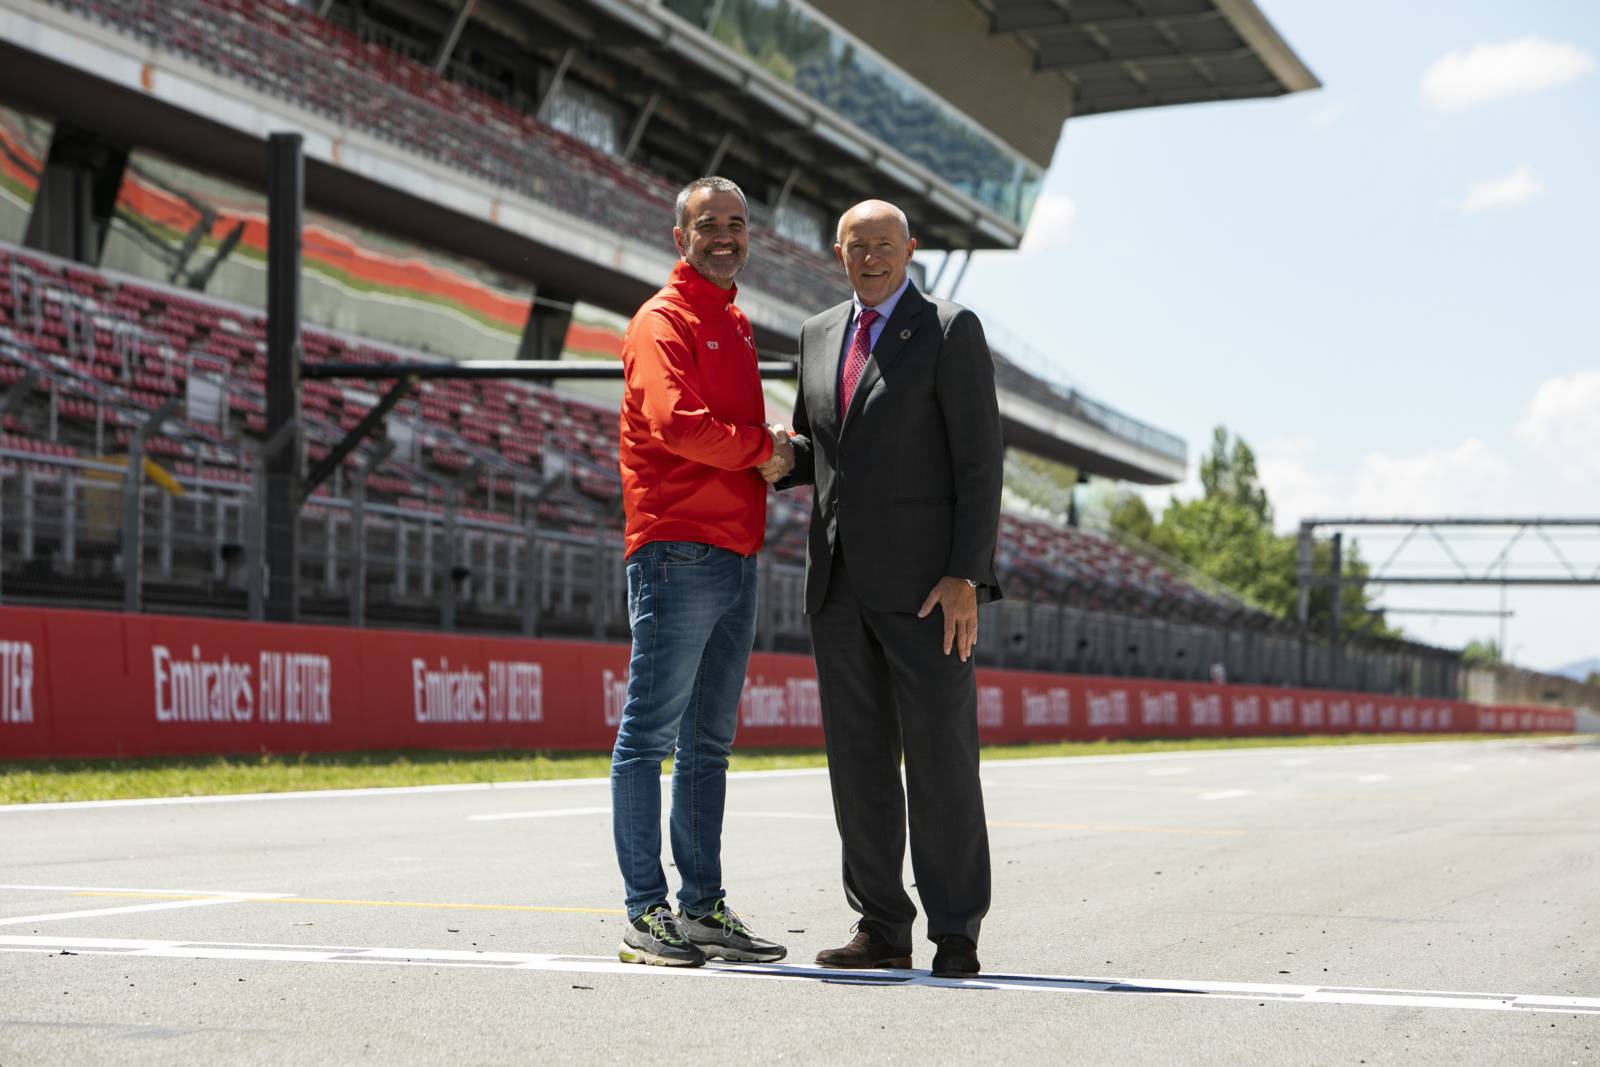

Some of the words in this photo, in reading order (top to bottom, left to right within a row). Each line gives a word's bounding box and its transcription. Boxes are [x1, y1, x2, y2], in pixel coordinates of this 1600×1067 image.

[152, 645, 253, 721] Emirates
[260, 652, 282, 721] FLY
[285, 653, 331, 723] BETTER
[412, 656, 486, 722] Emirates
